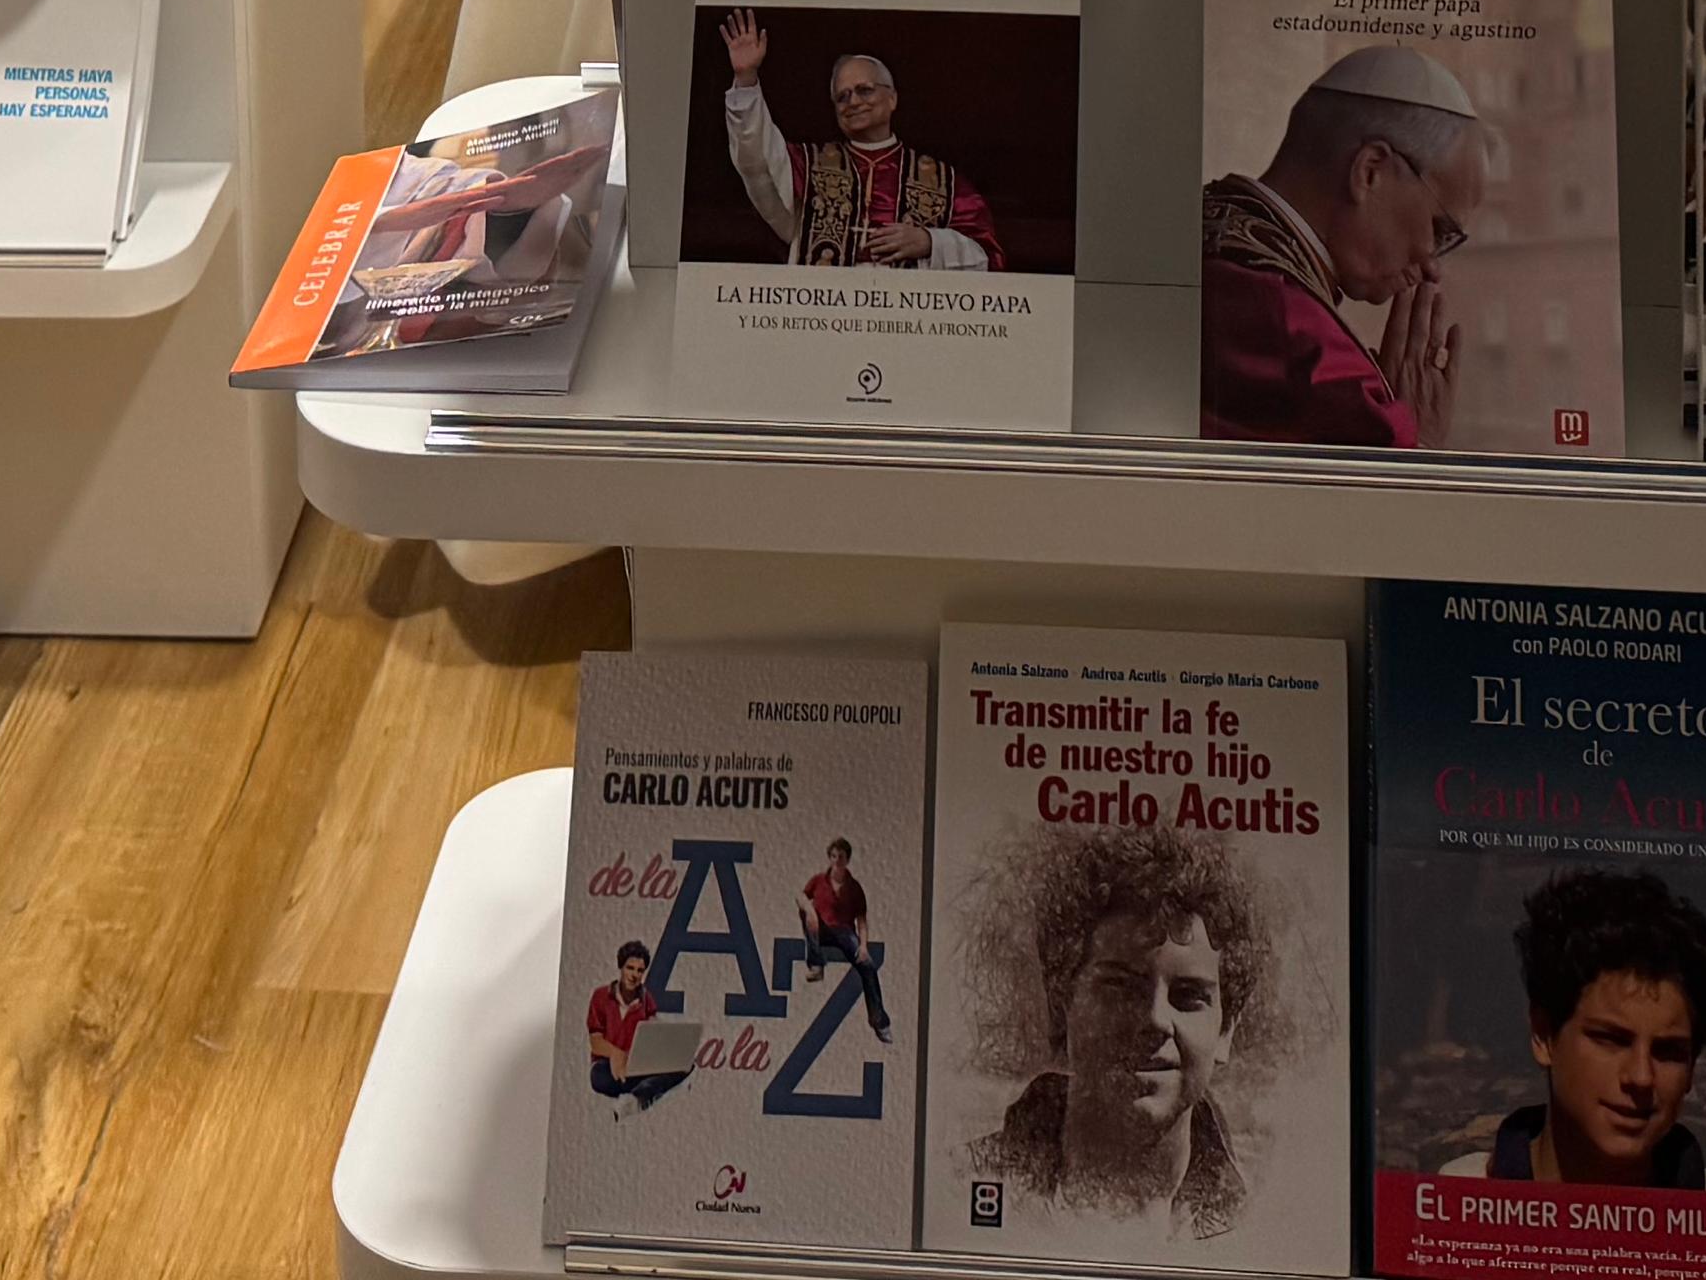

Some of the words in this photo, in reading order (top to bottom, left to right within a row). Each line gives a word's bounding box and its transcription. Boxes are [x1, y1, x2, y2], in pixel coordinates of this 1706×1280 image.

[1272, 14, 1425, 35] estadounidense
[1430, 23, 1444, 40] y
[1450, 22, 1537, 41] agustino
[4, 67, 74, 82] MIENTRAS
[79, 69, 113, 83] HAYA
[0, 103, 26, 117] HAY
[30, 104, 108, 118] ESPERANZA
[36, 86, 110, 102] PERSONAS,
[292, 199, 364, 309] CELEBRAR
[716, 285, 742, 304] LA
[749, 286, 847, 307] HISTORIA
[854, 290, 893, 309] DEL
[900, 292, 974, 312] NUEVO
[981, 294, 1032, 315] PAPA
[1444, 595, 1549, 626] ANTONIA
[1555, 603, 1662, 632] SALZANO
[748, 701, 829, 723] FRANCESCO
[833, 705, 901, 725] POLOPOLI
[971, 689, 1149, 732] Transmitir
[1162, 698, 1192, 734] la
[1205, 701, 1239, 736] fe
[1470, 675, 1526, 727] El
[1005, 732, 1047, 769] de
[1061, 741, 1193, 776] nuestro
[1207, 741, 1271, 786] hijo
[603, 772, 689, 806] CARLO
[695, 776, 789, 810] ACUTIS
[1038, 776, 1159, 827] Carlo
[1175, 782, 1320, 836] Acutis
[1415, 1183, 1450, 1222] EL
[1461, 1196, 1558, 1228] PRIMER
[1569, 1203, 1655, 1234] SANTO
